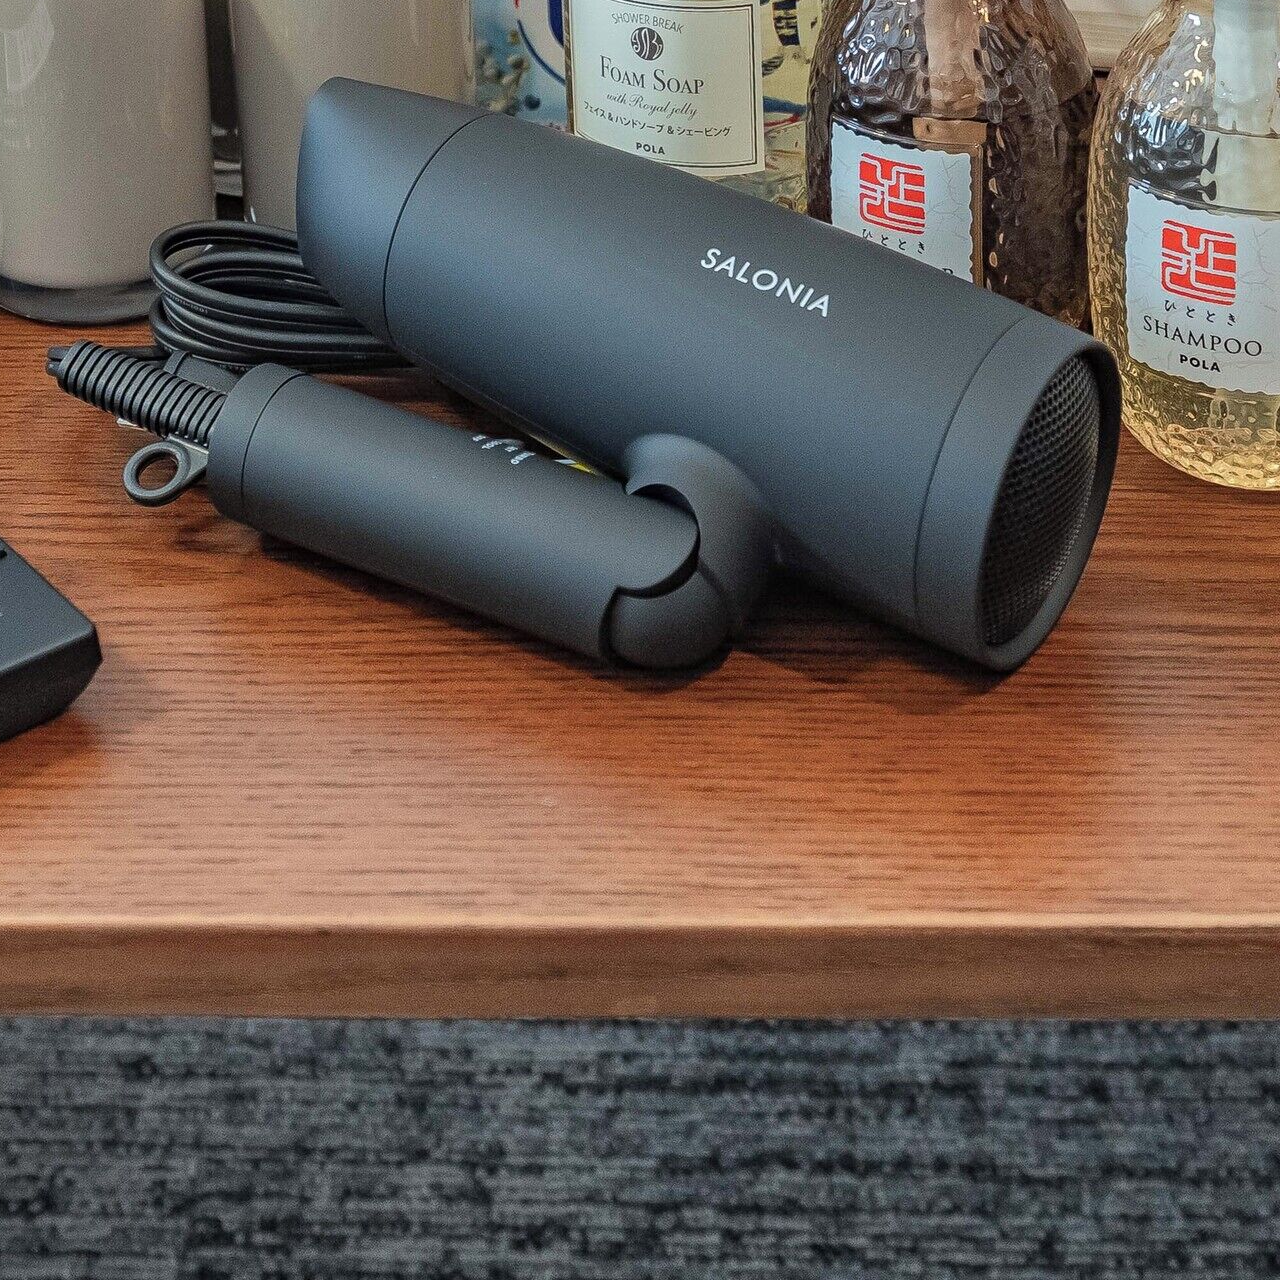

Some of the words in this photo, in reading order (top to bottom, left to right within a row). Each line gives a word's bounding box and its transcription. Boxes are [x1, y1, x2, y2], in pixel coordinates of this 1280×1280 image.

[611, 12, 651, 25] SHOWER
[652, 16, 685, 34] BREAK
[606, 91, 628, 106] with
[629, 93, 670, 116] Royal
[667, 101, 698, 121] jelly
[635, 142, 666, 155] POLA
[862, 228, 926, 254] ひととき
[700, 247, 830, 318] SALONIA
[1164, 299, 1238, 326] ひととき
[1143, 315, 1262, 357] SHAMPOO
[1180, 354, 1221, 373] POLA
